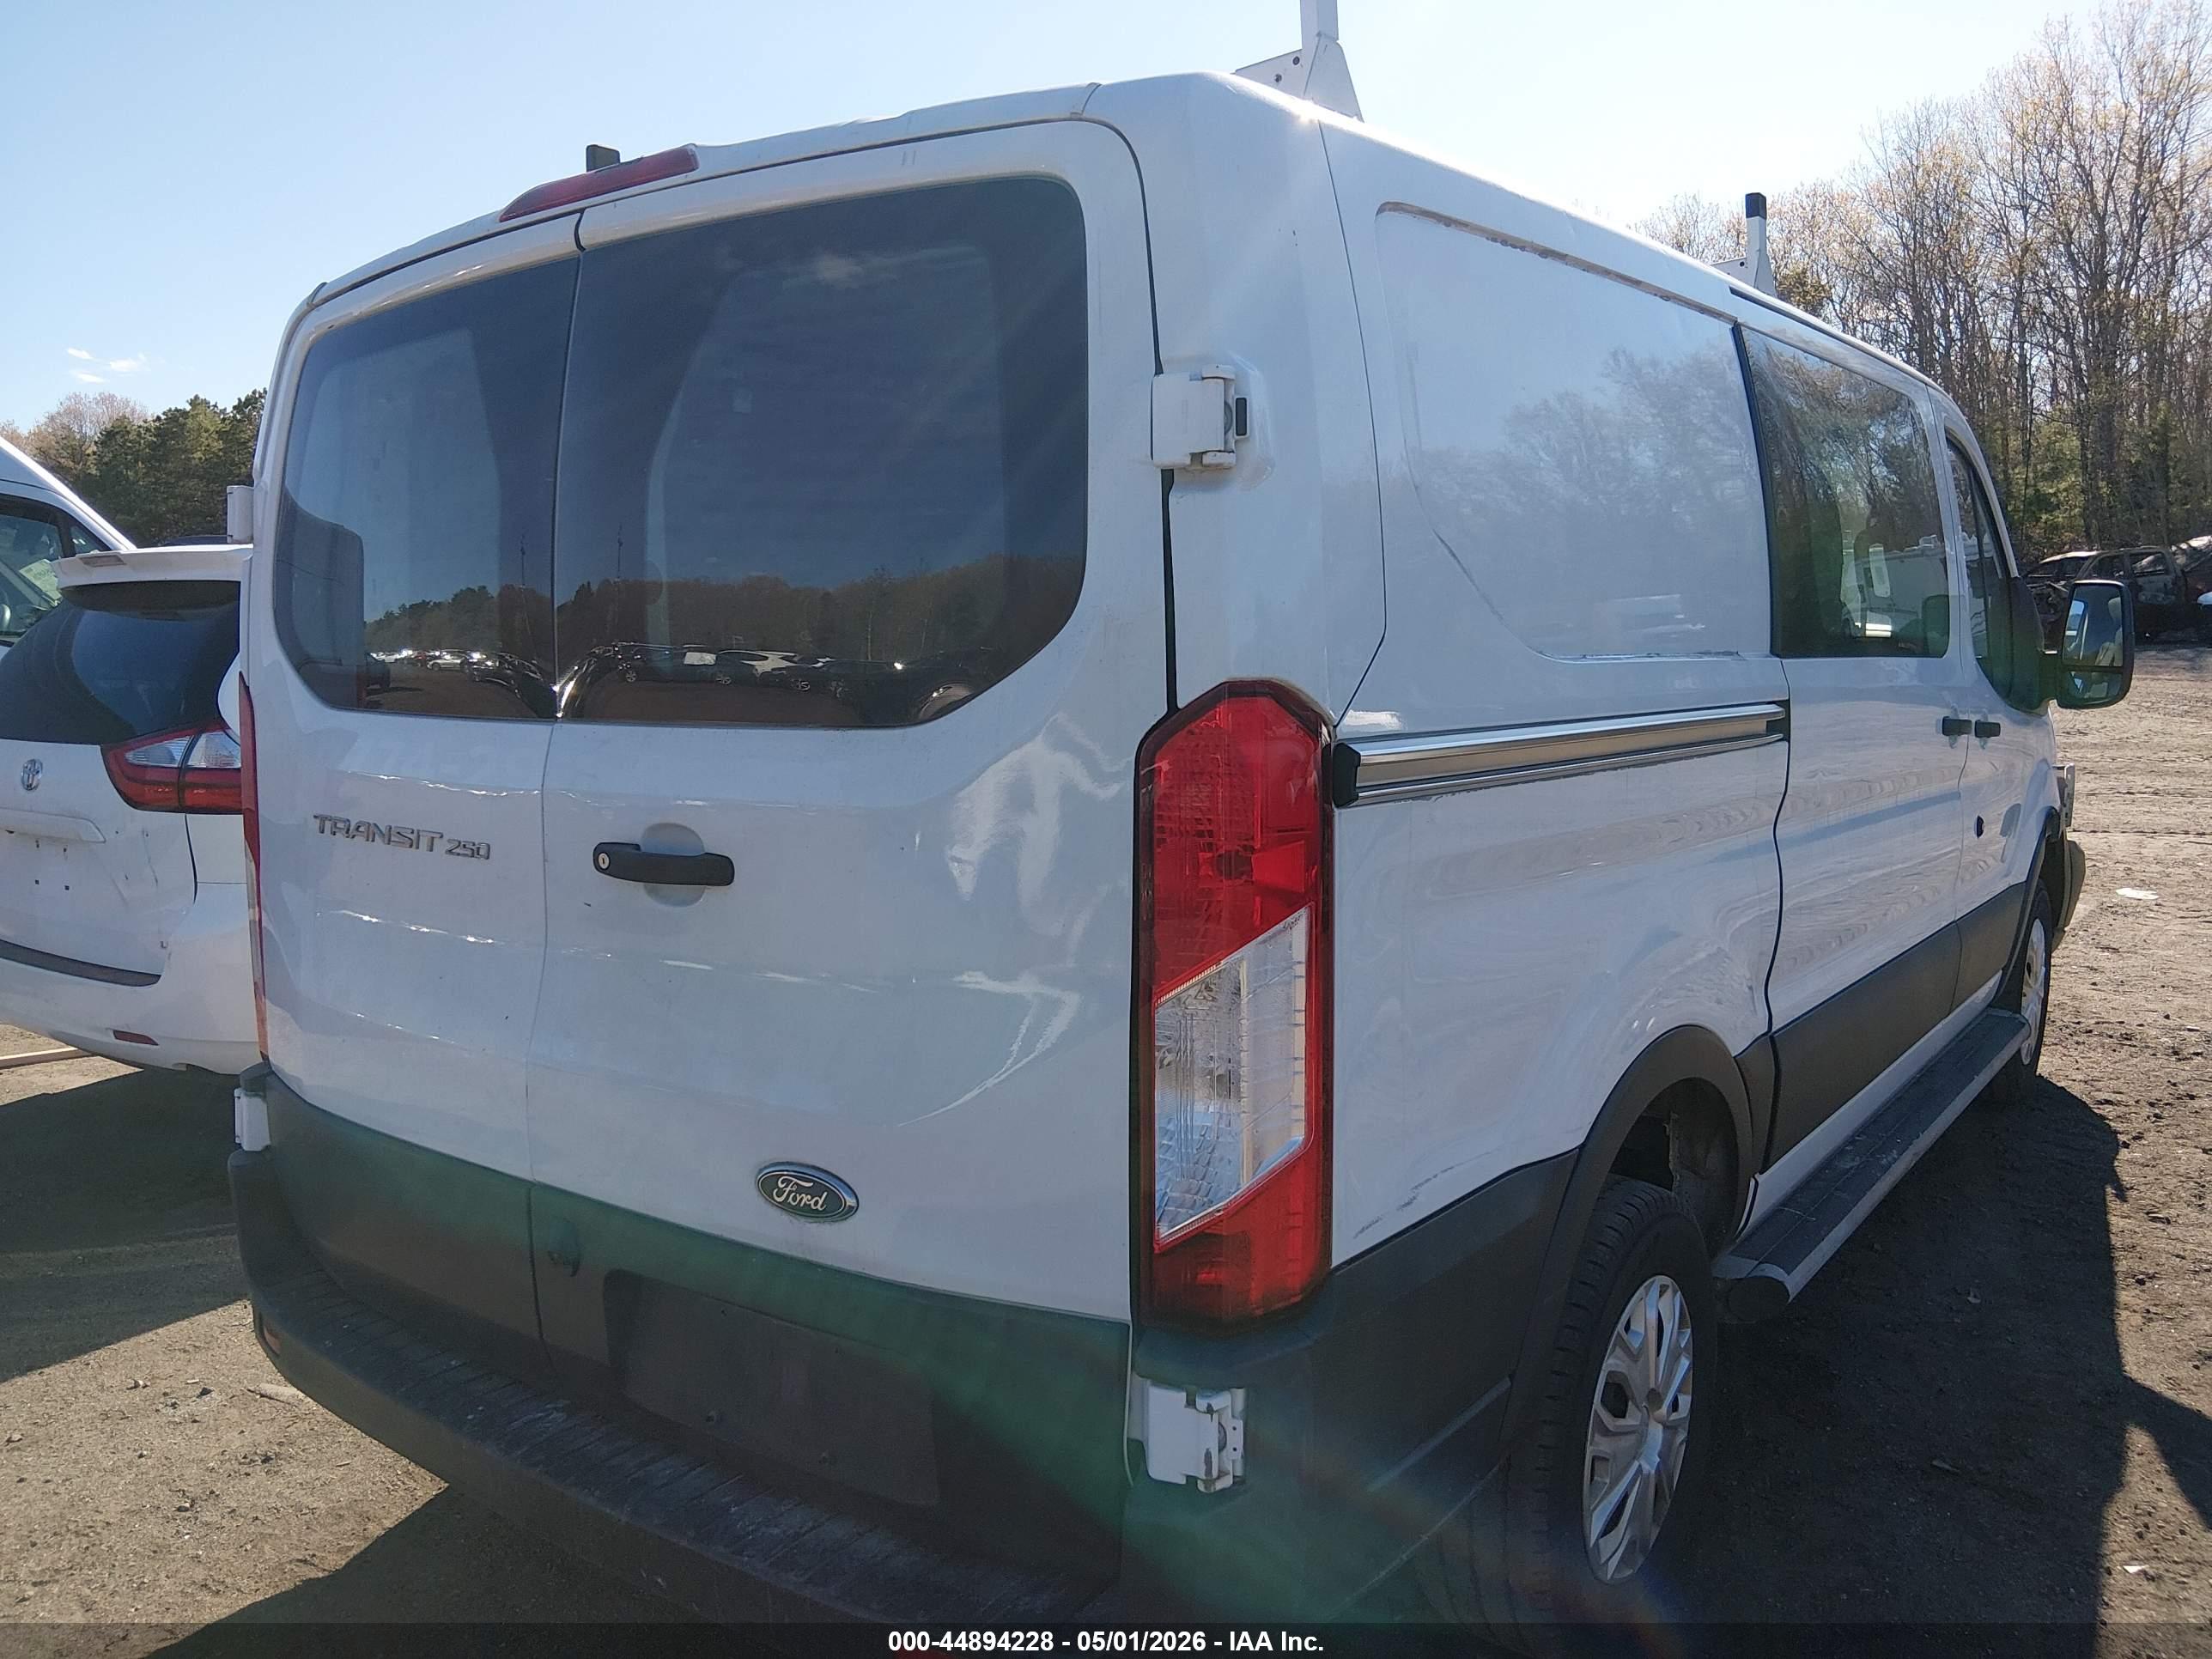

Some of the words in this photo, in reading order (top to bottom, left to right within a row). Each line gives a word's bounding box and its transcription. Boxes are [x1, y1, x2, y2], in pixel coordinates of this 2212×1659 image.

[313, 813, 444, 853] TRANSIT
[445, 838, 491, 860] 250
[772, 1176, 829, 1212] Ford
